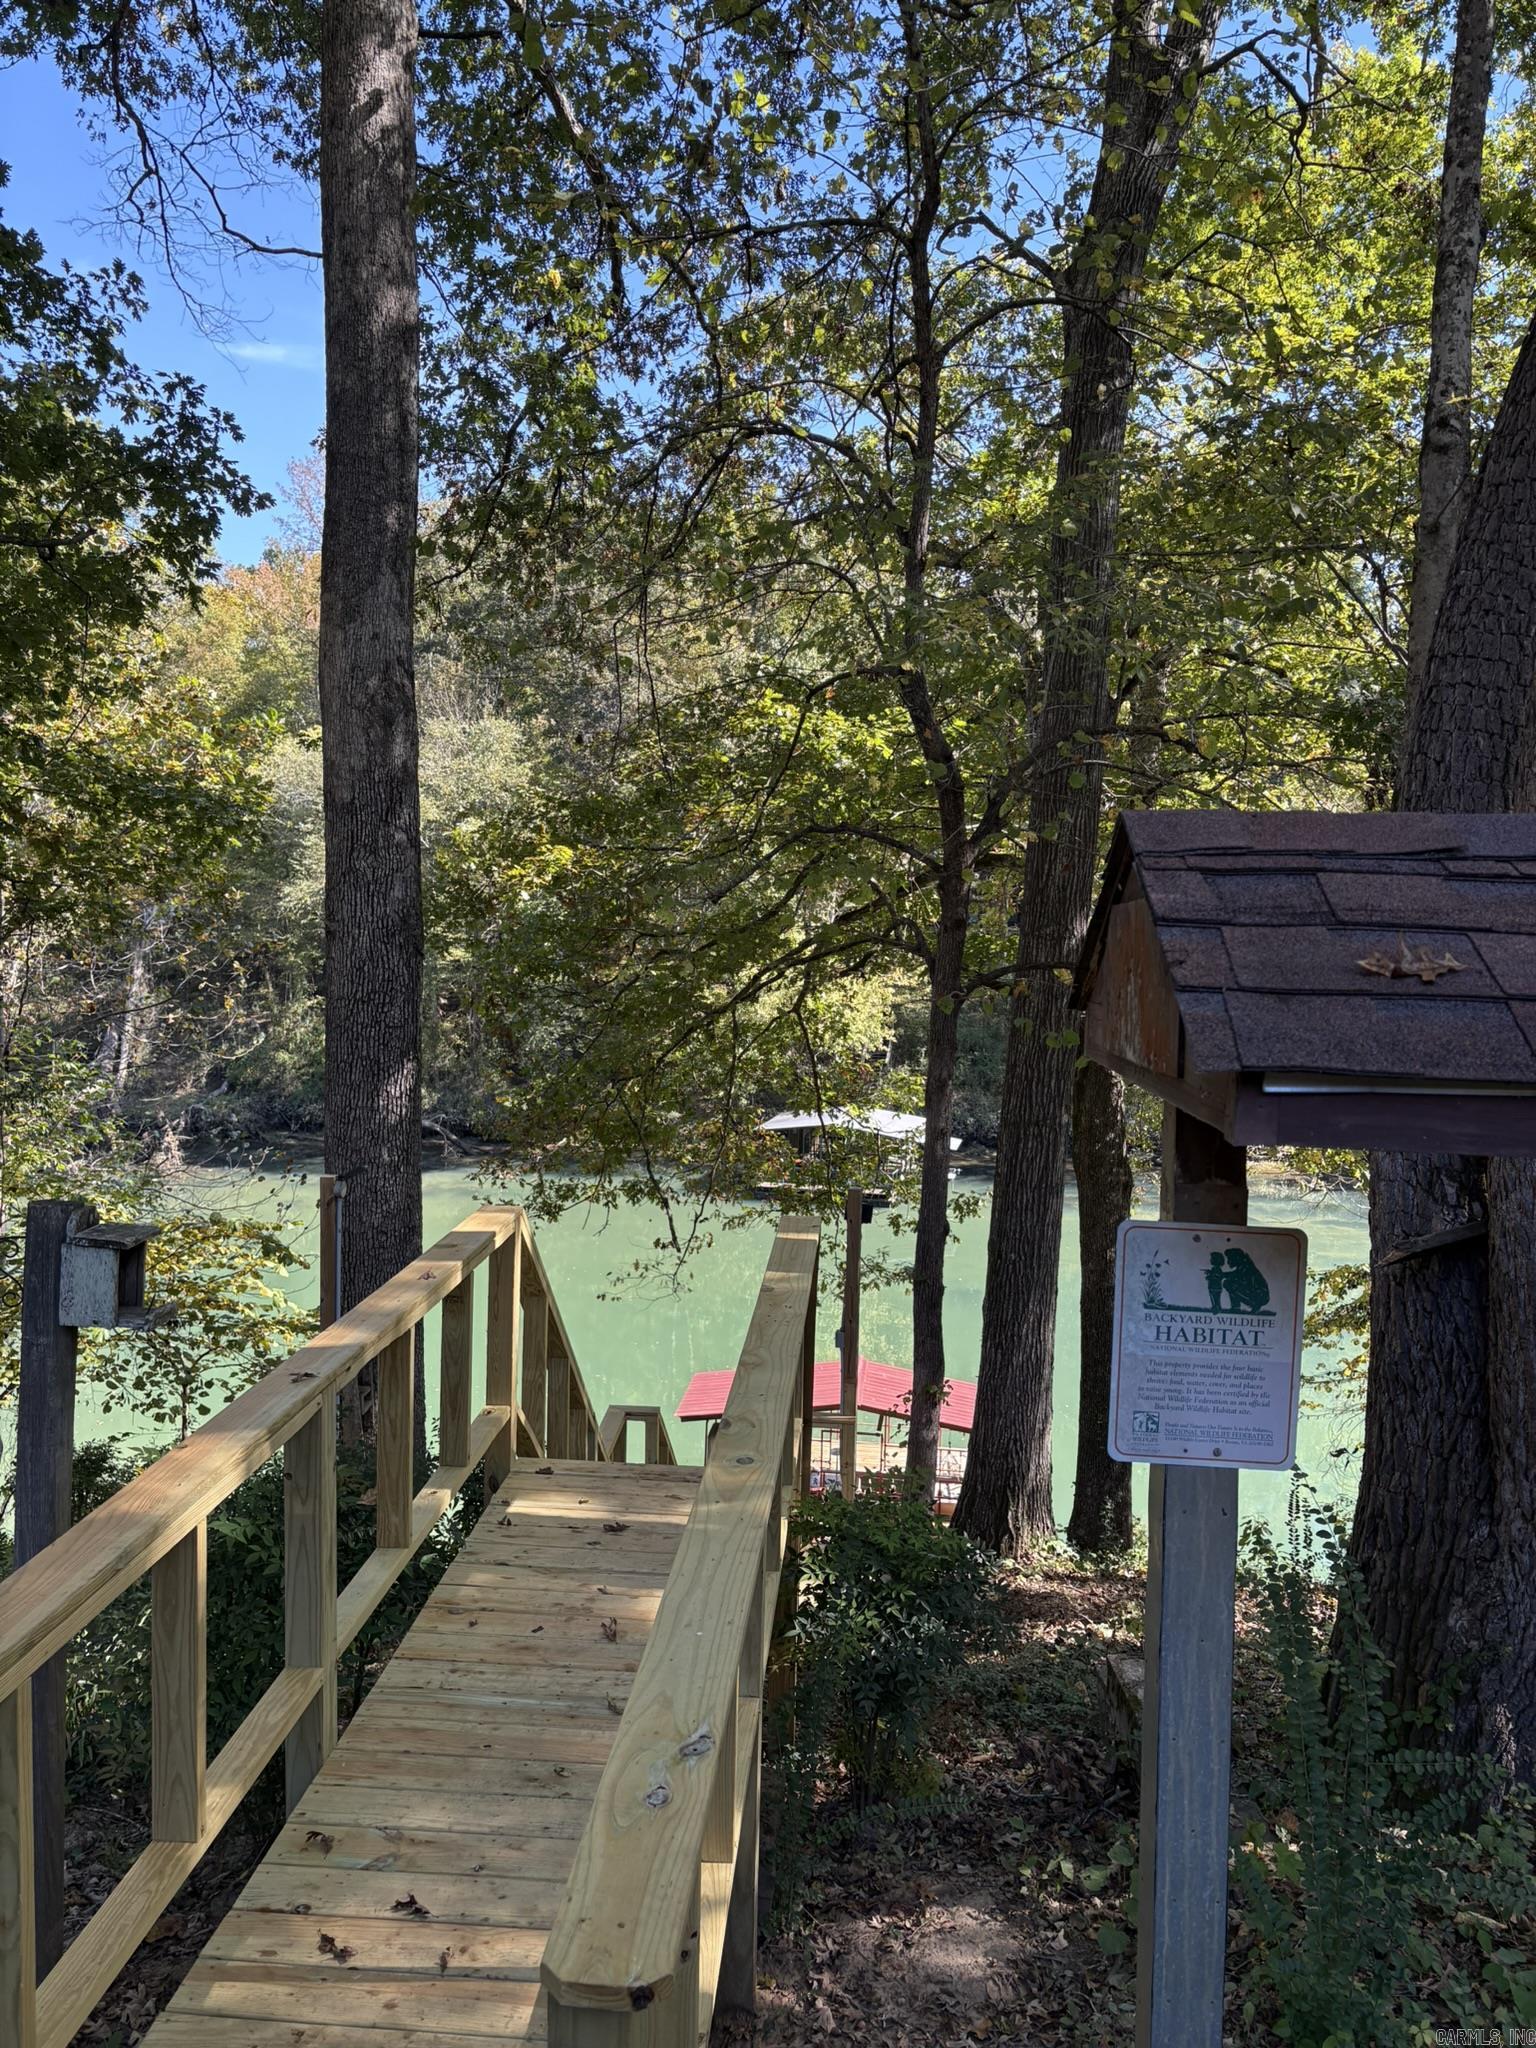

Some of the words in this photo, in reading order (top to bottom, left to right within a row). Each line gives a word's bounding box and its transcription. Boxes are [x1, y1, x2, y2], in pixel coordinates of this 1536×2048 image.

[1144, 1312, 1213, 1325] BACKYARD
[1216, 1316, 1275, 1328] WILDLIFE
[1155, 1325, 1265, 1346] HABITAT
[1149, 1344, 1185, 1352] NATIONAL
[1188, 1346, 1220, 1355] WILDLIFE
[1149, 1359, 1163, 1367] This
[1164, 1361, 1191, 1370] property
[1192, 1362, 1219, 1371] provides
[1220, 1363, 1231, 1371] the
[1232, 1364, 1246, 1372] four
[1247, 1364, 1264, 1373] basic
[1145, 1367, 1168, 1376] habitat
[1169, 1369, 1199, 1378] elements
[1199, 1370, 1222, 1379] needed
[1223, 1372, 1233, 1381] for
[1233, 1372, 1258, 1382] wildlife
[1229, 1381, 1242, 1389] and
[1242, 1382, 1264, 1391] places
[1137, 1392, 1166, 1401] National
[1167, 1394, 1193, 1403] Wildlife
[1194, 1395, 1229, 1405] Federation
[1248, 1399, 1271, 1409] official
[1186, 1387, 1192, 1395] It
[1193, 1387, 1205, 1395] has
[1206, 1388, 1222, 1396] been
[1222, 1389, 1250, 1398] certified
[1250, 1390, 1259, 1400] by
[1259, 1391, 1271, 1400] the
[1154, 1402, 1185, 1413] Backyard
[1186, 1404, 1211, 1413] Wildlife
[1212, 1405, 1237, 1415] Habitat
